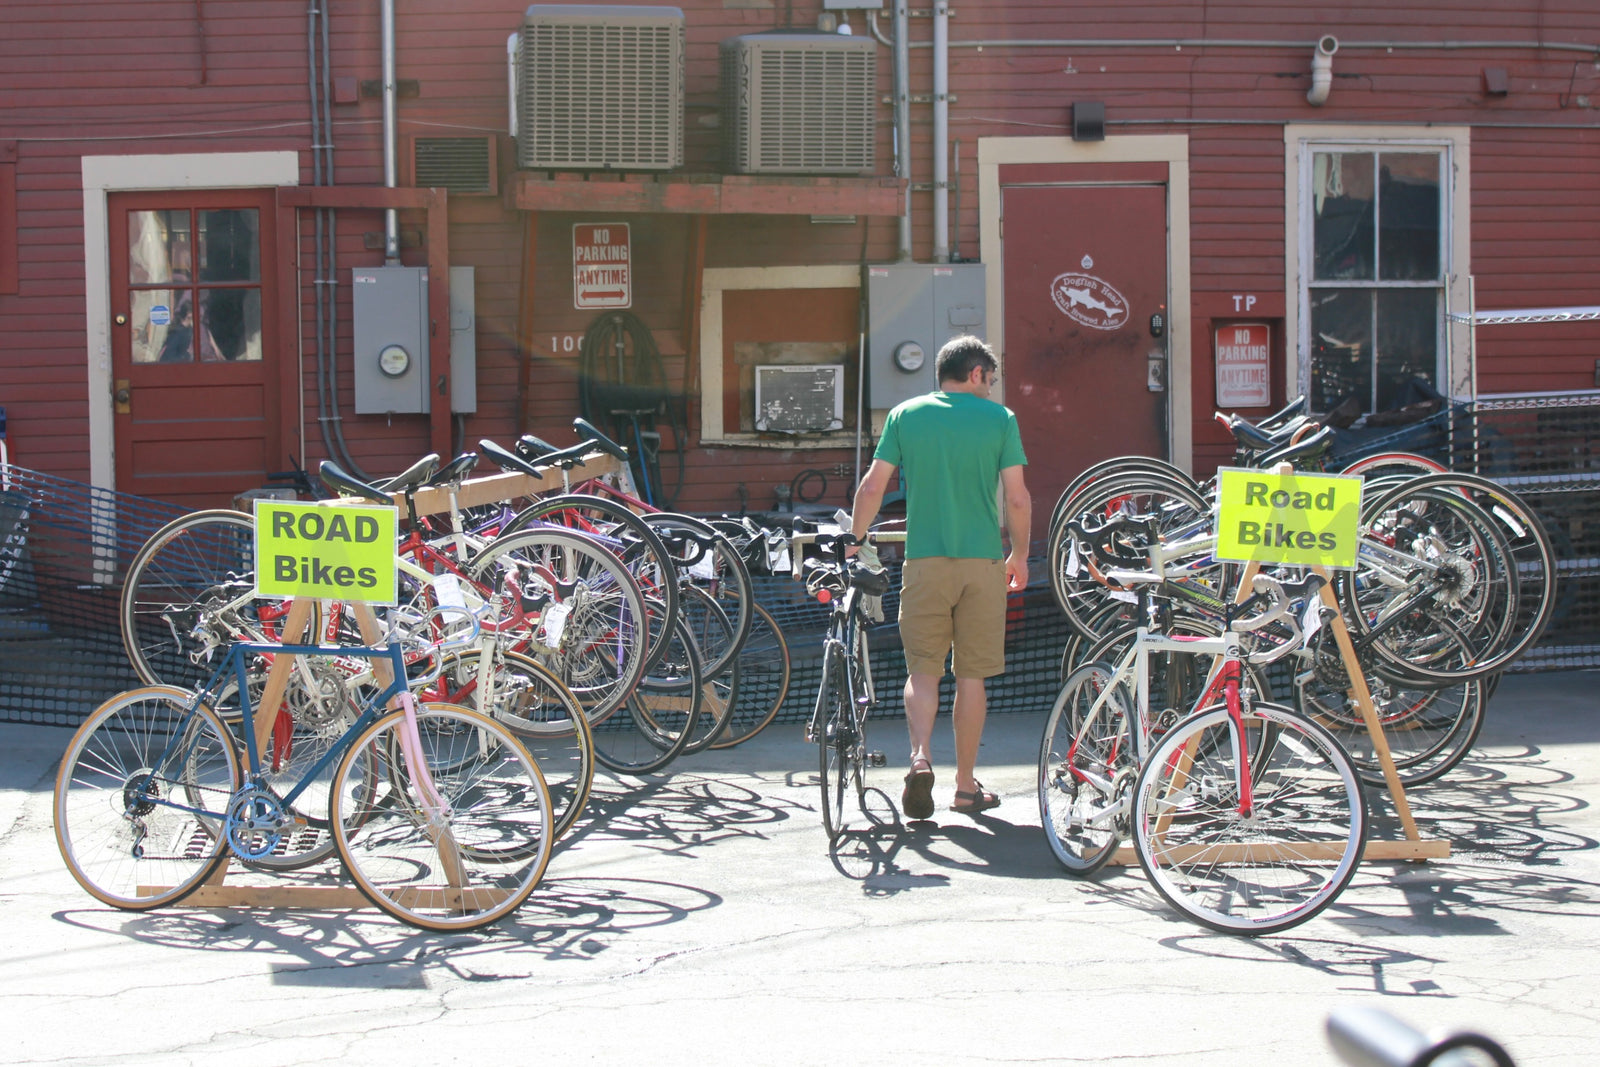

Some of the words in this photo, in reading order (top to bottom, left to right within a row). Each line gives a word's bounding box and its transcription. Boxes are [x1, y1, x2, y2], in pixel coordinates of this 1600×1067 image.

[593, 229, 610, 244] NO
[576, 245, 628, 261] PARKING
[579, 269, 627, 285] ANYTIME
[1063, 278, 1098, 290] Dogfish
[1101, 286, 1121, 306] Head
[1232, 295, 1257, 312] TP
[1234, 329, 1251, 345] NO
[1218, 345, 1267, 361] PARKING
[1220, 368, 1265, 384] ANYTIME
[1245, 481, 1336, 511] Road
[272, 511, 379, 543] ROAD
[1237, 520, 1337, 551] Bikes
[274, 555, 377, 588] Bikes
